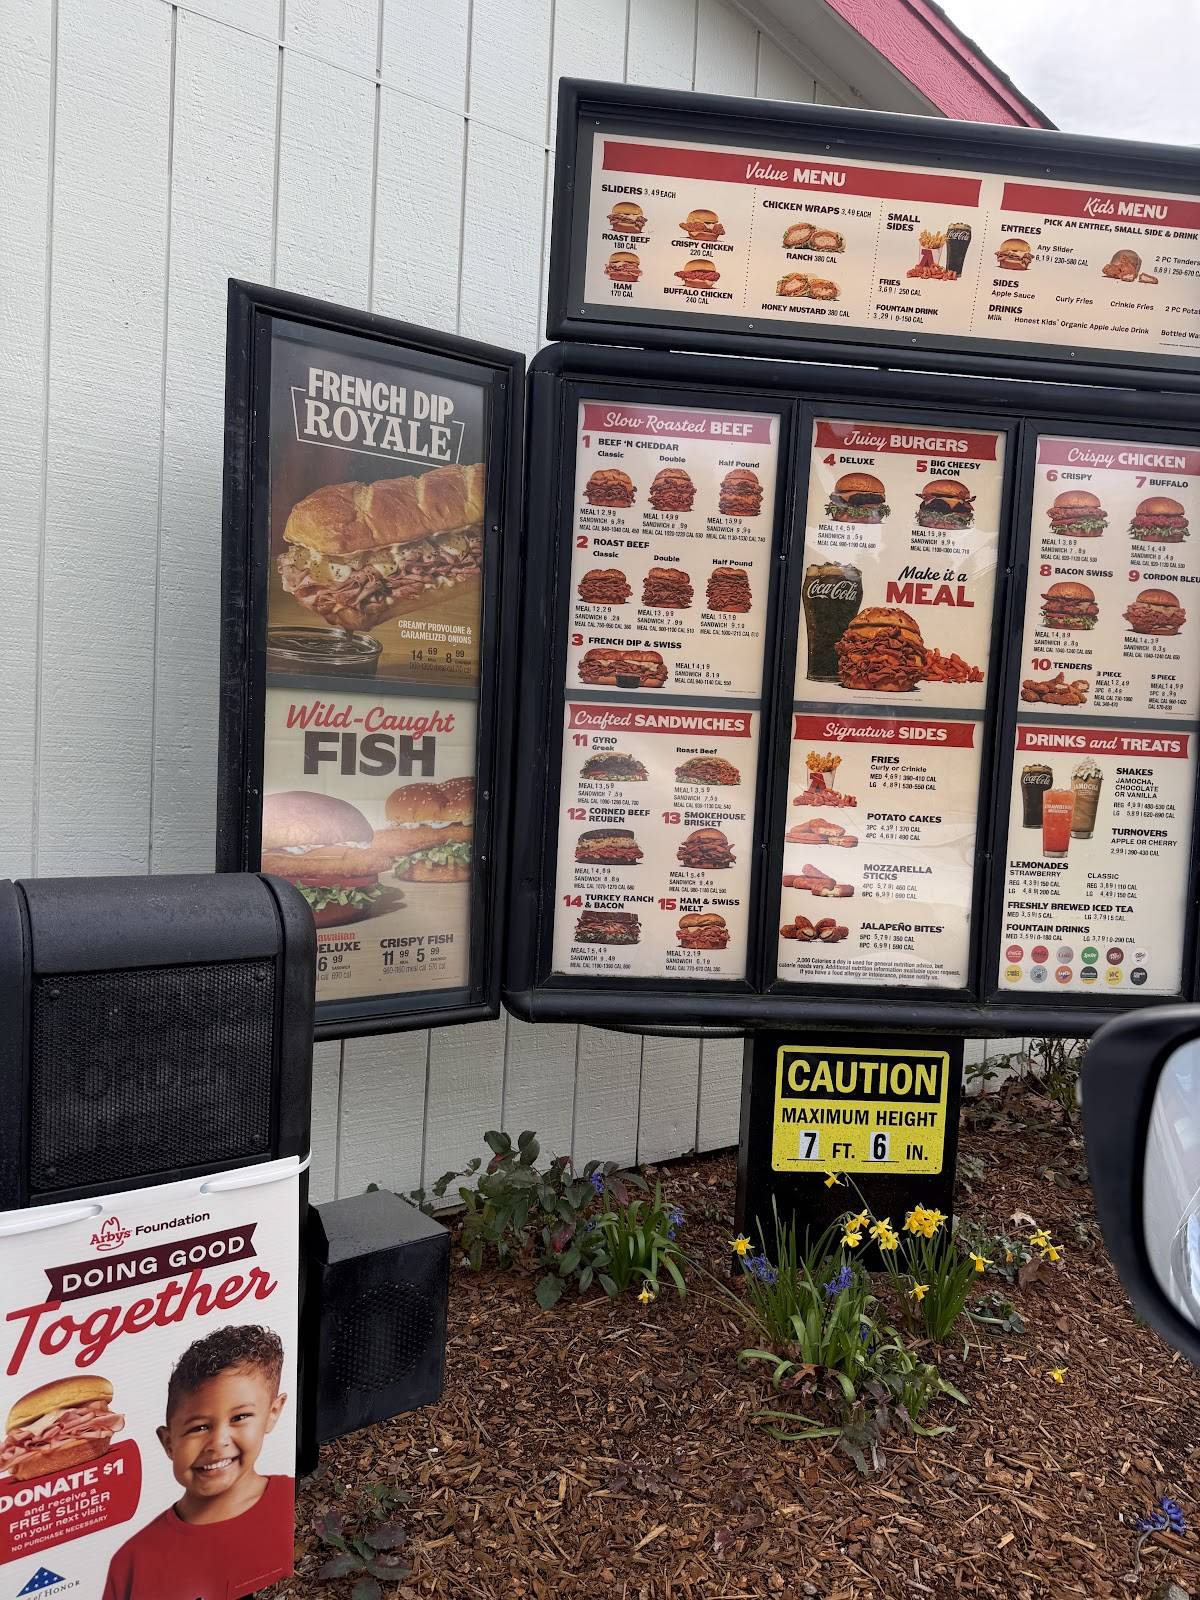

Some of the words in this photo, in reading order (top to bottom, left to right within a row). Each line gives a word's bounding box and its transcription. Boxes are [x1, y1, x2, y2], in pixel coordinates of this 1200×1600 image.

[746, 161, 788, 182] Value
[793, 168, 846, 187] MENU
[602, 184, 642, 195] SLIDERS
[660, 190, 676, 199] EACH
[763, 200, 802, 212] CHICKEN
[805, 204, 840, 215] WRAPS
[856, 210, 872, 218] EACH
[1084, 197, 1114, 216] Kids
[1118, 204, 1168, 220] MENU
[888, 213, 920, 223] SMALL
[887, 222, 914, 232] SIDES
[1001, 224, 1041, 235] ENTREES
[1044, 219, 1062, 227] PICK
[1079, 222, 1112, 232] ENTREE,
[1114, 225, 1142, 234] SMALL
[1144, 228, 1163, 236] SIDE
[1173, 231, 1198, 240] DRINK
[602, 234, 627, 242] ROAST
[629, 236, 650, 244] BEEF
[671, 240, 699, 249] CRISPY
[701, 242, 734, 252] CHICKEN
[1037, 244, 1053, 252] Any
[1055, 245, 1073, 254] Slider
[786, 253, 812, 261] RANCH
[1174, 258, 1200, 266] Tenders
[993, 279, 1019, 288] SIDES
[664, 287, 697, 296] BUFFALO
[700, 290, 732, 299] CHICKEN
[762, 304, 787, 312] HONEY
[789, 306, 826, 316] MUSTARD
[989, 304, 1022, 314] DRINKS
[1014, 316, 1039, 325] Honest
[1060, 320, 1088, 329] Organic
[1110, 325, 1128, 333] Juice
[1131, 326, 1149, 334] Drink
[1161, 330, 1186, 338] Bottled
[308, 367, 406, 416] FRENCH
[413, 390, 454, 424] DIP
[304, 399, 451, 461] ROYALE
[604, 412, 644, 428] Slow
[646, 415, 706, 433] Roasted
[710, 421, 753, 437] BEEF
[599, 438, 622, 446] BEEF
[635, 441, 679, 451] CHEDDAR
[844, 431, 888, 451] Juicy
[890, 435, 968, 452] BURGERS
[840, 457, 875, 465] DELUXE
[1068, 448, 1116, 468] Crispy
[1118, 453, 1185, 469] CHICKEN
[948, 462, 981, 470] CHEESY
[1150, 479, 1188, 488] BUFFALO
[594, 539, 624, 547] ROAST
[898, 566, 941, 582] Make
[944, 569, 954, 581] it
[1040, 564, 1051, 577] 8
[1129, 570, 1139, 582] 9
[886, 581, 974, 607] MEAL
[398, 620, 426, 631] CREAMY
[427, 624, 465, 634] PROVOLONE
[401, 630, 446, 642] CARAMELIZED
[448, 635, 472, 644] ONIONS
[589, 637, 624, 646] FRENCH
[653, 640, 682, 649] SWISS
[1032, 658, 1051, 670] 10
[286, 701, 455, 740] Wild-Caught
[575, 711, 632, 730] Crafted
[634, 714, 745, 731] SANDWICHES
[823, 722, 895, 741] Signature
[898, 727, 947, 741] SIDES
[1026, 733, 1086, 747] DRINKS
[1090, 737, 1118, 749] and
[1121, 738, 1180, 752] TREATS
[304, 731, 436, 777] FISH
[568, 808, 586, 820] 12
[662, 812, 681, 824] 13
[684, 812, 746, 820] SMOKEHOUSE
[867, 813, 906, 822] POTATO
[909, 815, 942, 823] CAKES
[1112, 828, 1168, 837] TURNOVERS
[864, 864, 932, 874] MOZZARELLA
[1010, 861, 1069, 869] LEMONADES
[563, 895, 583, 907] 14
[658, 898, 677, 910] 15
[861, 922, 912, 931] JALAPEÑO
[318, 932, 355, 941] awaiian
[380, 936, 424, 948] CRISPY
[428, 934, 454, 944] FISH
[316, 942, 360, 953] ELUXE
[788, 1060, 937, 1095] CAUTION
[782, 1108, 869, 1125] MAXIMUM
[876, 1110, 937, 1127] HEIGHT
[804, 1133, 816, 1158] 7
[833, 1143, 854, 1158] FT.
[874, 1134, 886, 1159] 6
[906, 1145, 928, 1160] IN.
[90, 1228, 131, 1245] Arby's
[136, 1211, 210, 1236] Foundation
[62, 1257, 158, 1293] DOING
[169, 1236, 244, 1268] GOOD
[6, 1266, 278, 1376] Together
[0, 1467, 98, 1513] DONATE
[103, 1459, 124, 1475] $1
[24, 1504, 44, 1516] and
[48, 1492, 86, 1507] receive
[10, 1513, 49, 1533] FREE
[56, 1492, 110, 1517] SLIDER
[14, 1531, 28, 1540] on
[29, 1522, 52, 1537] your
[56, 1514, 79, 1526] next
[81, 1506, 106, 1518] visit.
[24, 1530, 63, 1547] PURCHASE
[66, 1515, 108, 1533] NECESSARY
[45, 1580, 80, 1597] HONOR
